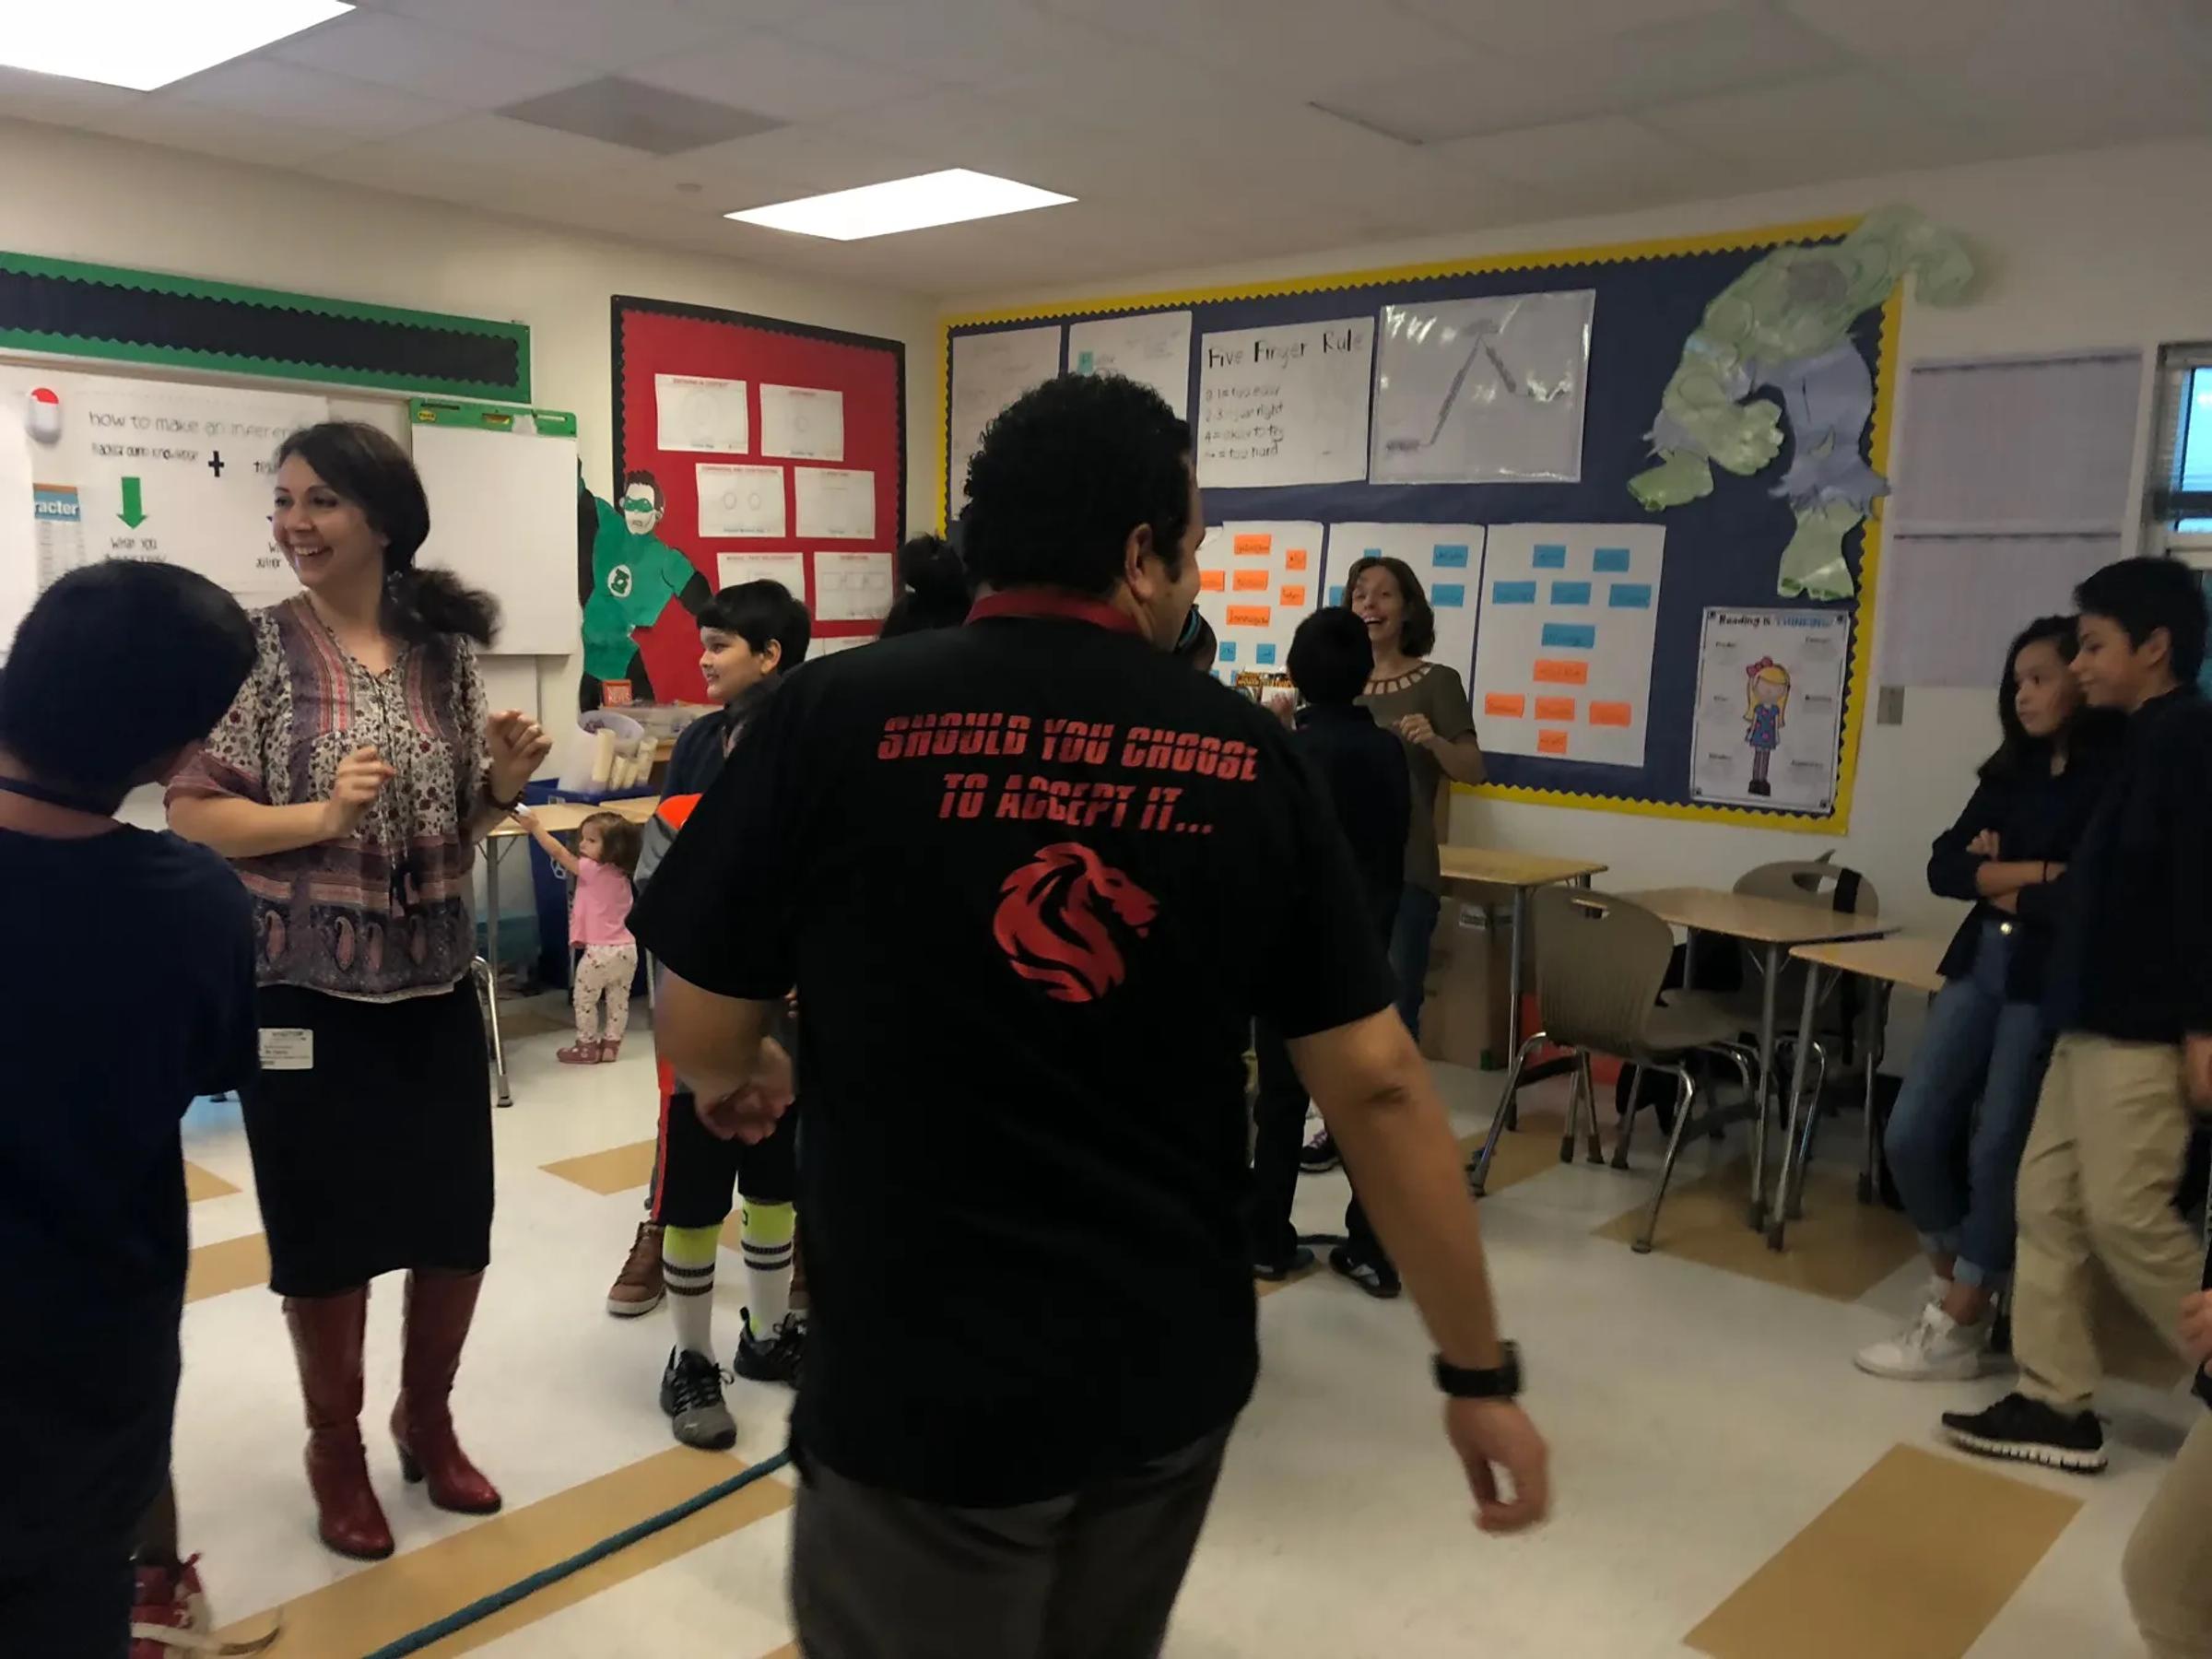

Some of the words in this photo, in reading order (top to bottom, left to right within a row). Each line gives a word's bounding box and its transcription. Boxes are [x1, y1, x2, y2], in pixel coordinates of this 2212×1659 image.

[1208, 347, 1243, 368] Five
[1254, 340, 1307, 369] Finger
[1324, 328, 1364, 354] Rule
[89, 411, 125, 427] how
[130, 416, 151, 430] to
[155, 417, 199, 432] make
[205, 420, 227, 436] an
[877, 712, 1030, 760] SHOULD
[1041, 718, 1115, 764] YOU
[1120, 725, 1258, 782] CHOOSE
[938, 772, 988, 819] TO
[995, 774, 1135, 828] ACCEPT
